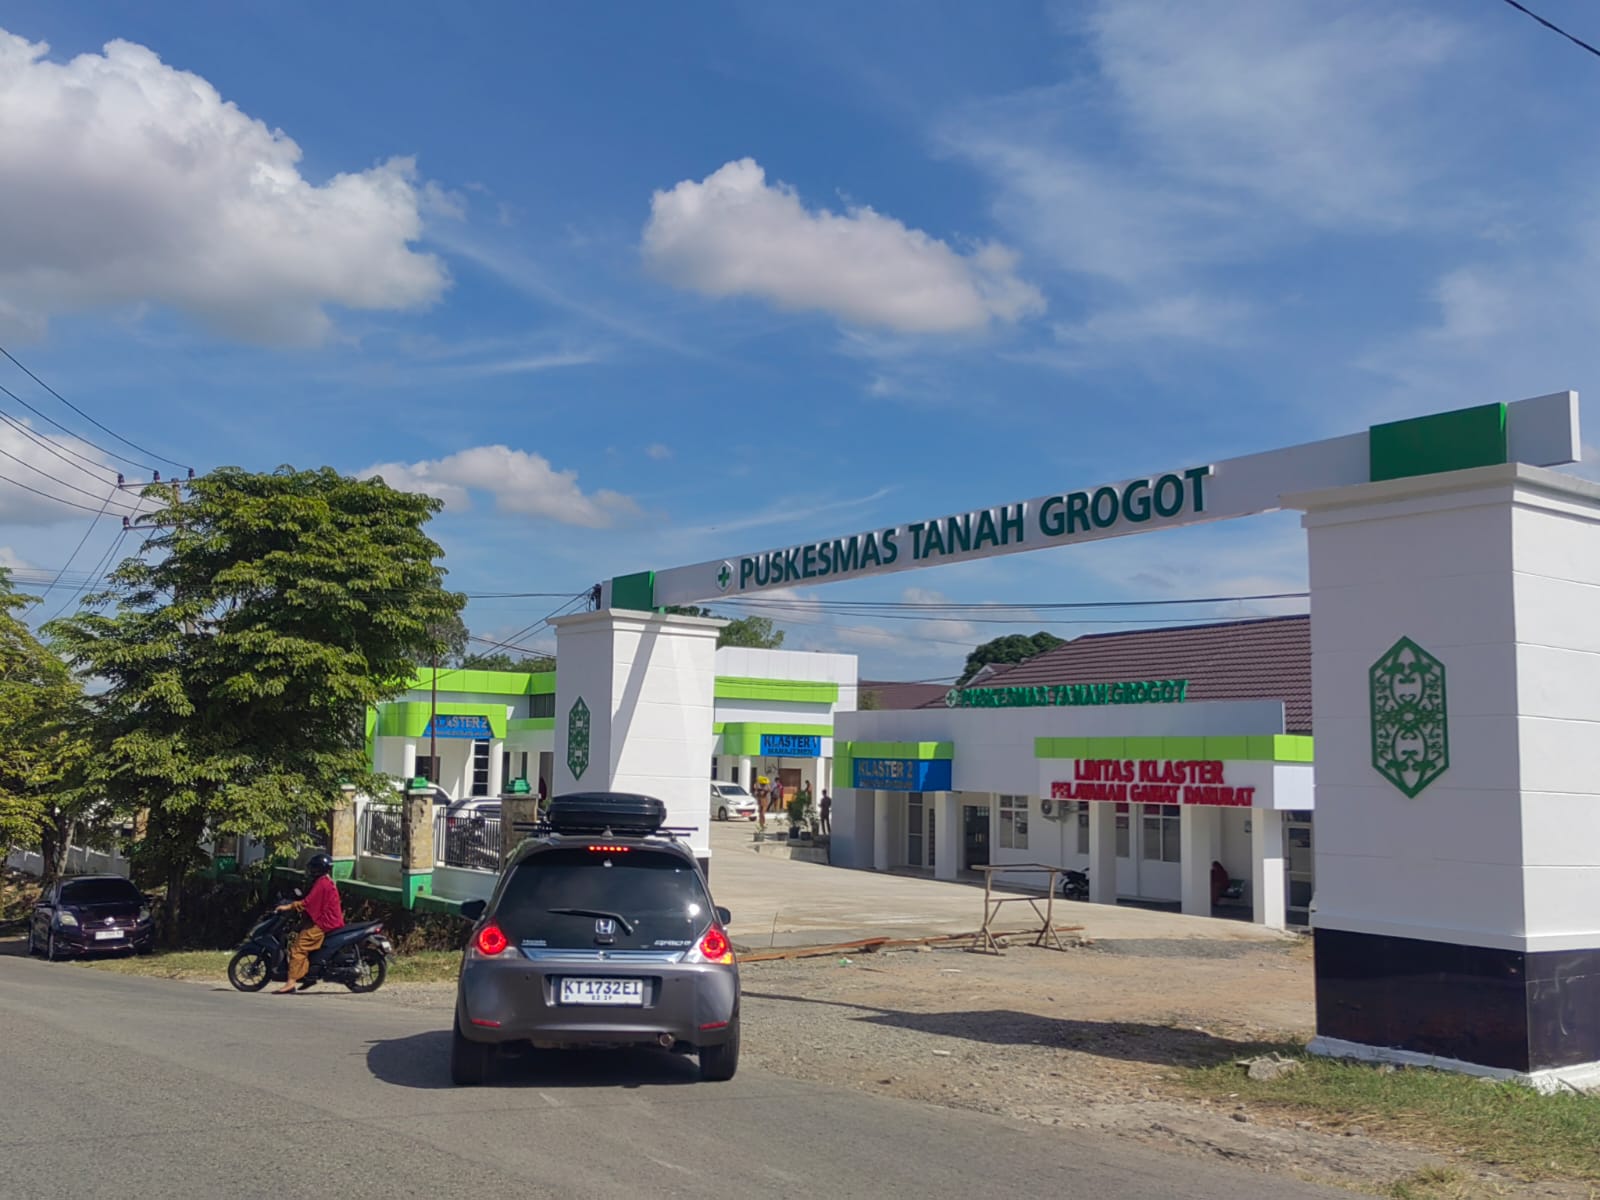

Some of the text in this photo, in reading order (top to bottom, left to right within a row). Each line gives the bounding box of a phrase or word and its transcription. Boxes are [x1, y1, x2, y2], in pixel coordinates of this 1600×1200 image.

[739, 465, 1215, 590] PUSKESMAS TANAH GROGOT
[1053, 682, 1109, 706] TANAH
[1112, 679, 1189, 704] GROGOT
[763, 735, 810, 748] KLASTER
[858, 760, 912, 778] KLASTER 2
[1074, 759, 1224, 784] LINTAS KLASTER
[1130, 784, 1180, 804] GAWAT
